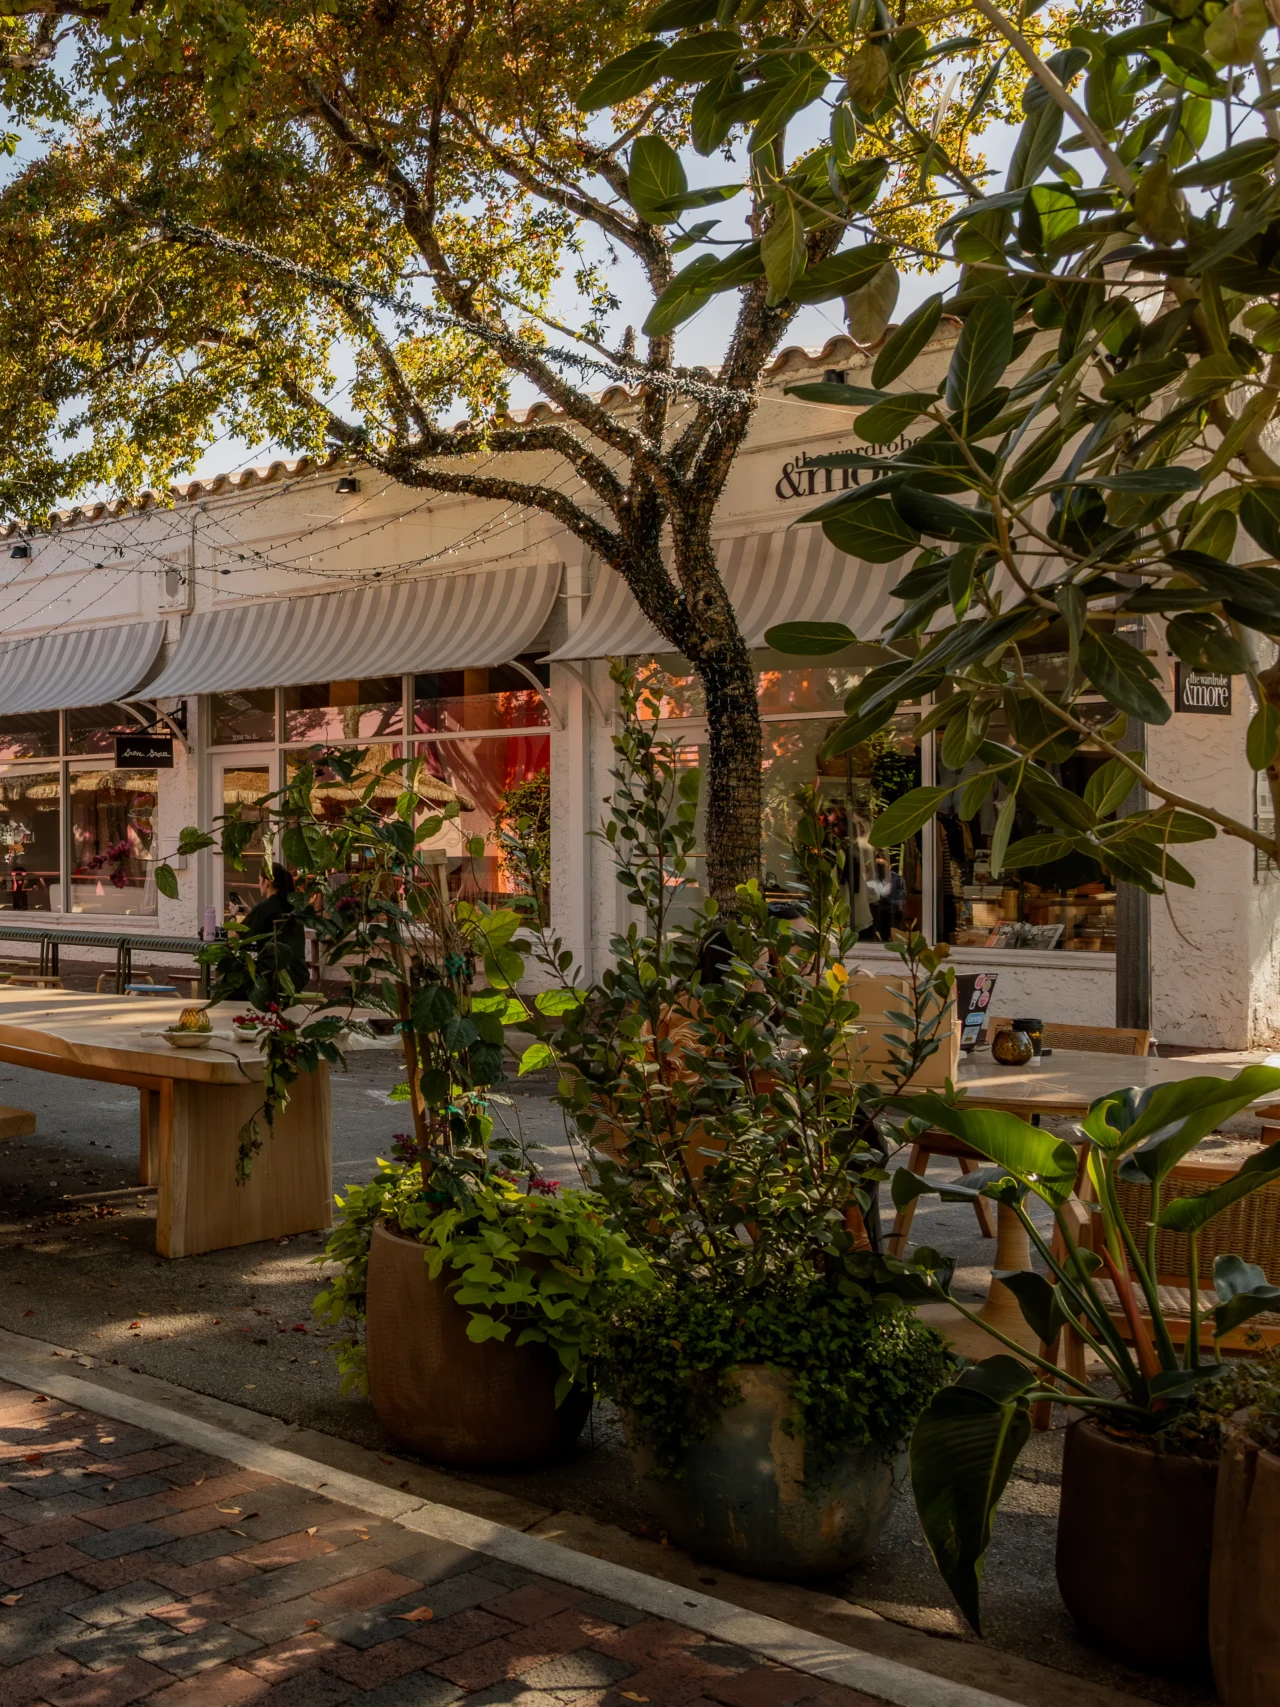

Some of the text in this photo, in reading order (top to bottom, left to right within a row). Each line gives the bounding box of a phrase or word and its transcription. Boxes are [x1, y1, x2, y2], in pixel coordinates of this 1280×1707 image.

[794, 451, 824, 469] th
[1189, 671, 1228, 687] the wardrobe
[1183, 677, 1229, 708] &more
